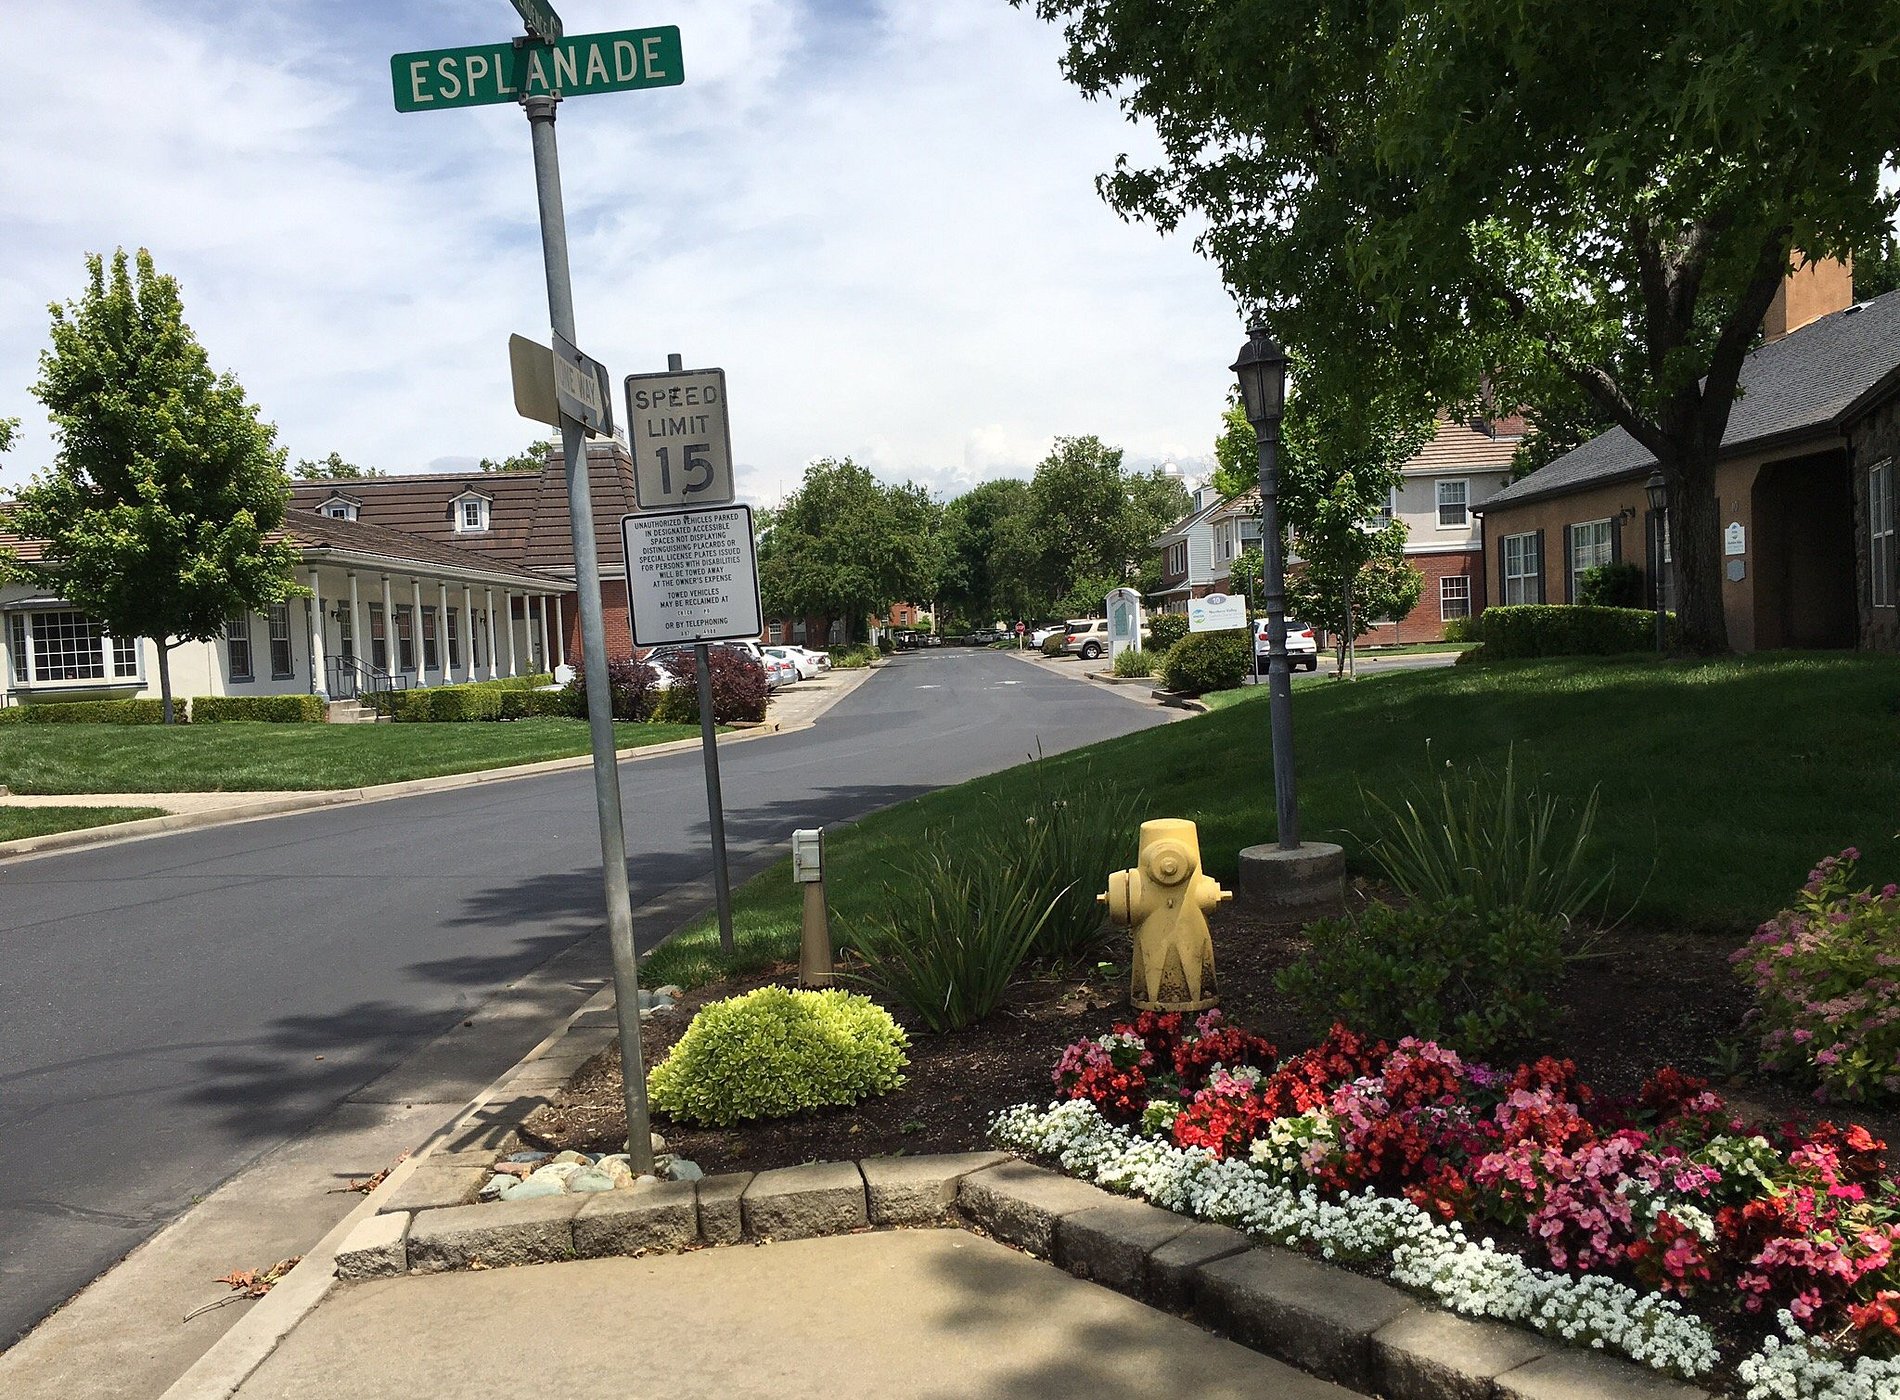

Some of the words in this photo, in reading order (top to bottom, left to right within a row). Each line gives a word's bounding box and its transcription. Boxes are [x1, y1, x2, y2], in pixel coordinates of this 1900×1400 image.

[410, 37, 666, 102] ESPLANADE
[577, 370, 596, 406] WAY
[635, 386, 717, 409] SPEED
[648, 415, 709, 437] LIMIT
[656, 443, 714, 494] 15
[634, 519, 681, 529] UNAUTHORIZED
[683, 515, 713, 525] VEHICLES
[714, 513, 739, 521] PARKED
[654, 526, 691, 536] DESIGNATED
[693, 523, 730, 533] ACCESSIBLE
[650, 537, 675, 545] SPACES
[676, 535, 688, 543] NOT
[690, 531, 726, 542] DISPLAYING
[642, 544, 692, 555] DISTINGUISHING
[693, 540, 725, 549] PLACARDS
[639, 554, 665, 563] SPECIAL
[666, 552, 692, 561] LICENSE
[694, 550, 717, 558] PLATES
[719, 548, 741, 556] ISSUED
[656, 562, 684, 570] PERSONS
[686, 560, 700, 568] WITH
[702, 557, 740, 566] DISABILITIES
[658, 571, 673, 579] WILL
[685, 568, 705, 576] TOWED
[662, 579, 673, 587] THE
[676, 577, 703, 586] OWNER'S
[704, 574, 732, 583] EXPENSE
[668, 590, 688, 599] TOWED
[689, 588, 720, 597] VEHICLES
[660, 601, 674, 609] MAY
[685, 597, 720, 606] RECLAIMED
[665, 622, 674, 630] OR
[686, 617, 729, 628] TELEPHONING
